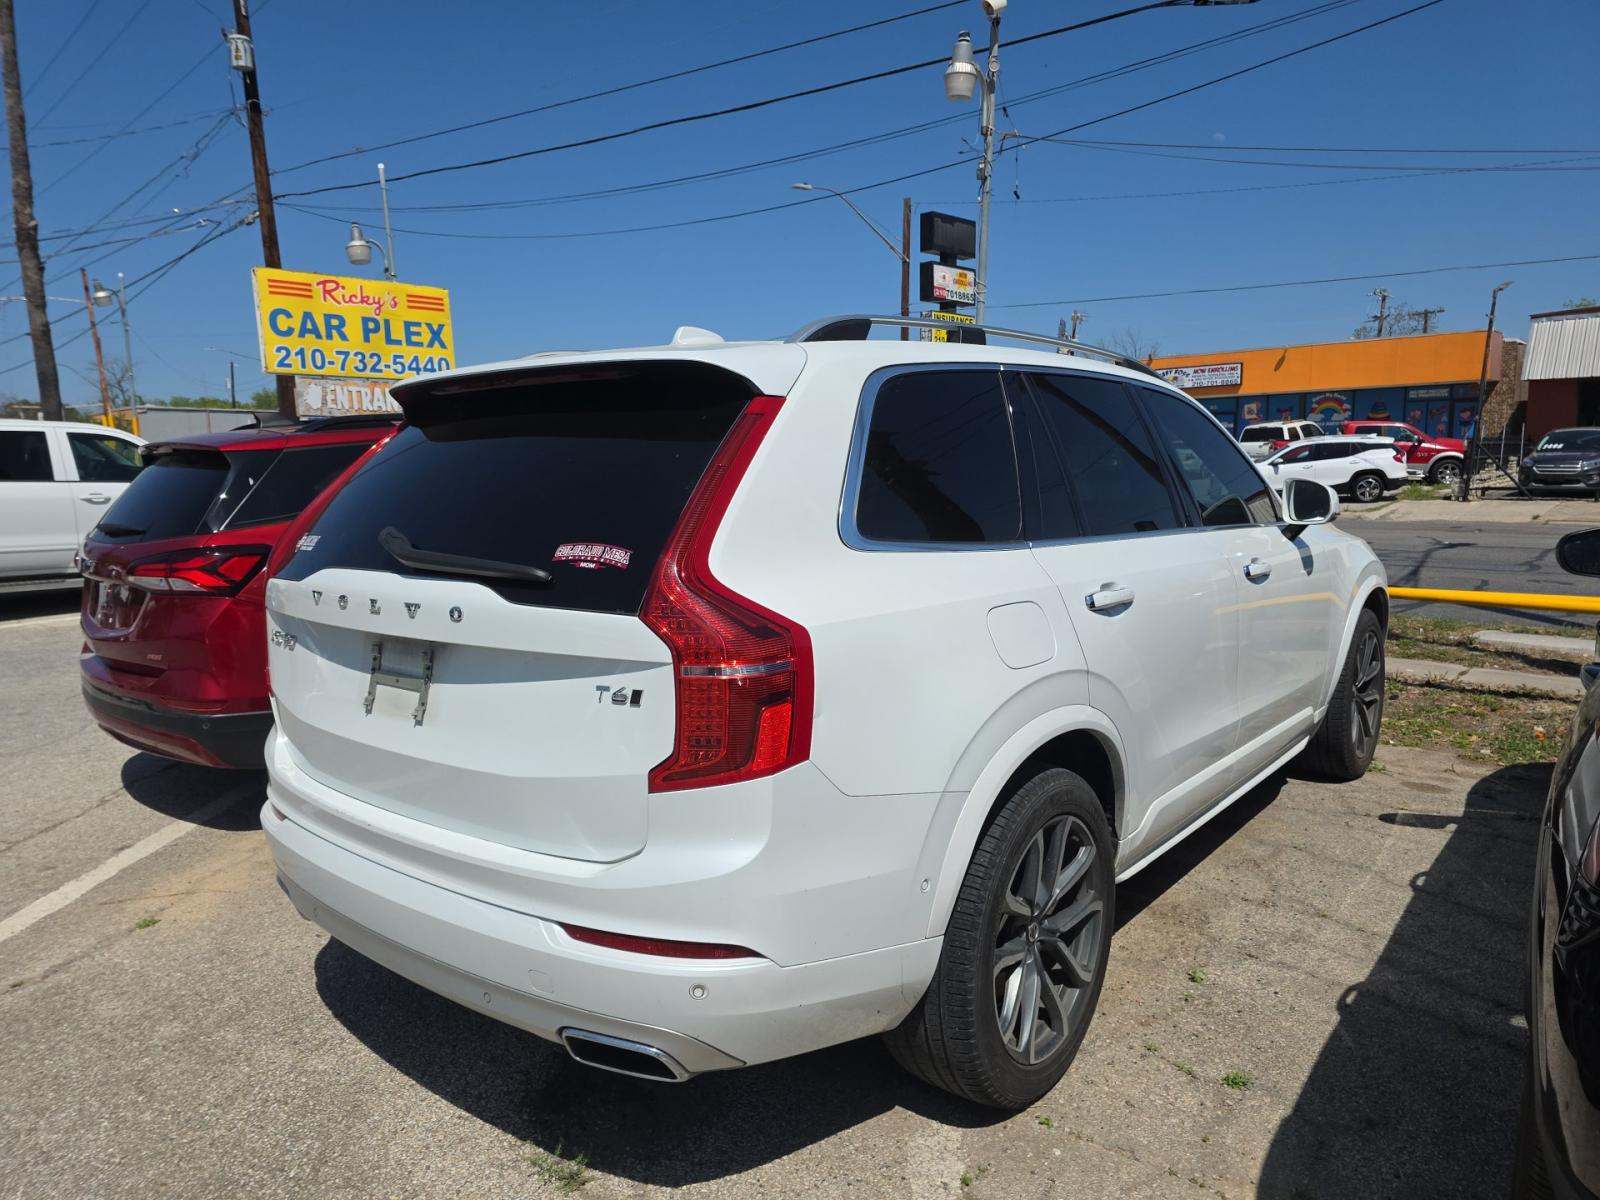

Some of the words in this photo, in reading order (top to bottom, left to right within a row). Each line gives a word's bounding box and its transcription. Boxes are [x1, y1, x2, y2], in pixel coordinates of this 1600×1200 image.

[316, 279, 399, 316] Ricky's
[268, 307, 350, 343] CAR
[360, 315, 449, 350] PLEX
[274, 345, 451, 375] 210-732-5440
[1207, 365, 1239, 374] ENROLLING
[579, 561, 596, 569] MOM
[602, 546, 631, 565] MESA
[312, 590, 464, 624] VOLVO
[595, 684, 629, 706] T6
